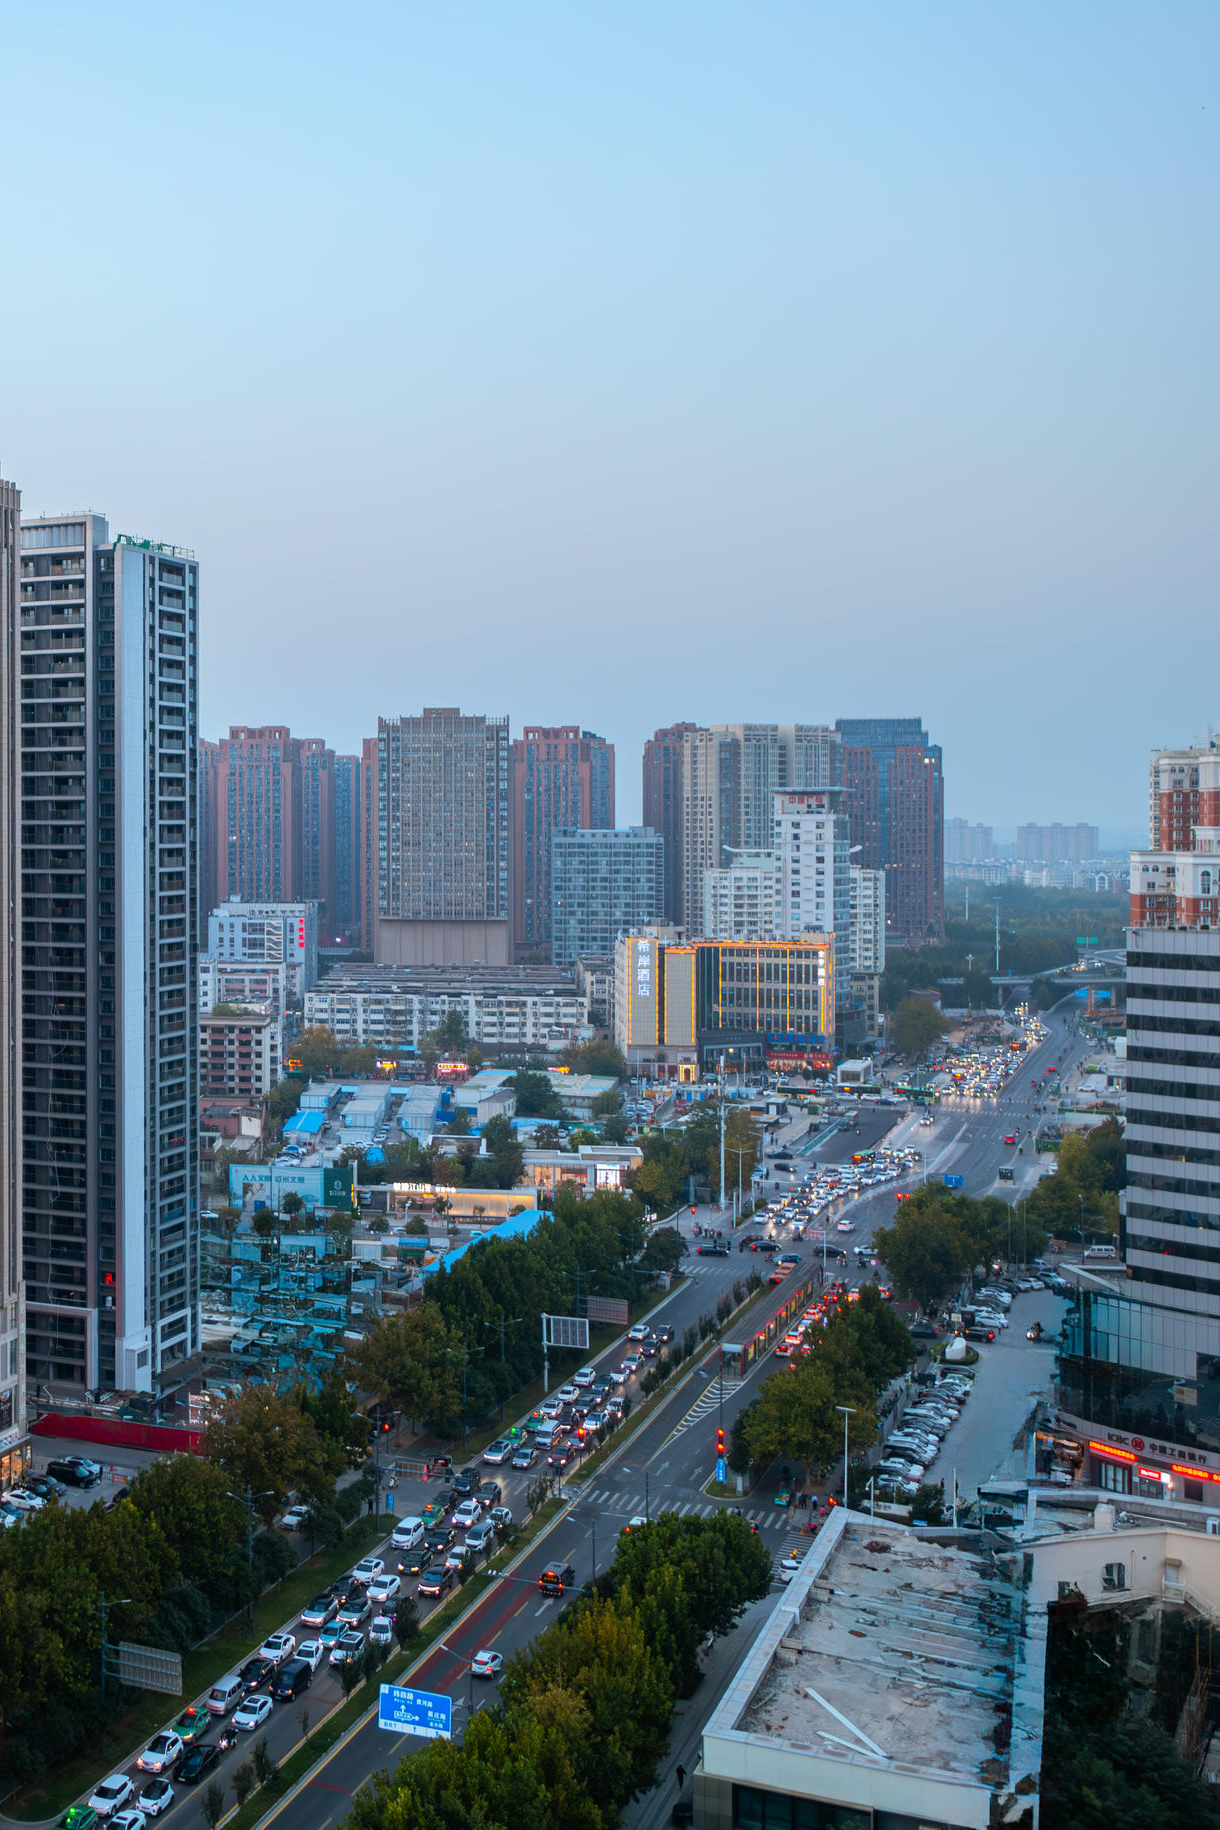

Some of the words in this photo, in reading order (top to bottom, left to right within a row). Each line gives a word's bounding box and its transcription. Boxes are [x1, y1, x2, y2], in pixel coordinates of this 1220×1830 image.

[637, 940, 651, 997] 希岸酒店
[1107, 1432, 1130, 1446] ICBC
[1149, 1443, 1207, 1464] 中国工商银行
